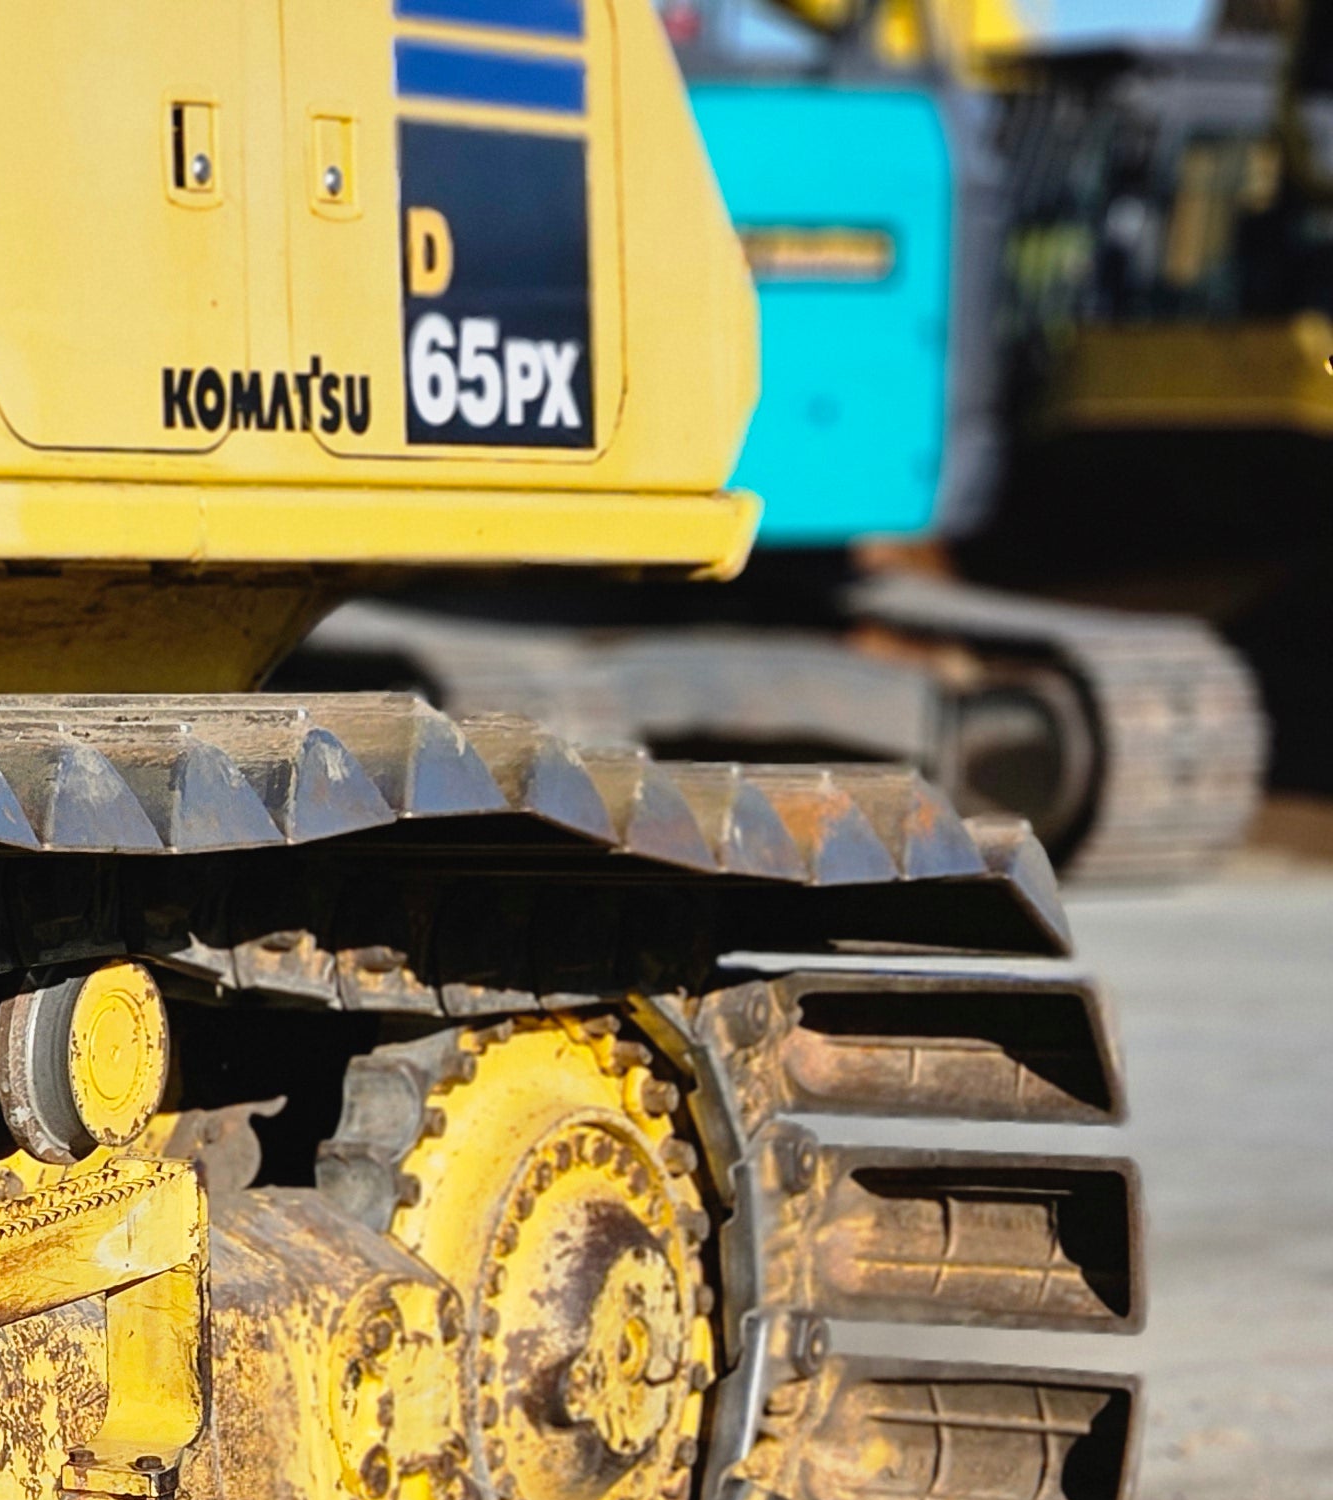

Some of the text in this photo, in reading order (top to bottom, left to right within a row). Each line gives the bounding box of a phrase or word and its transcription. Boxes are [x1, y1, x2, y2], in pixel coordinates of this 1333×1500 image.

[407, 207, 453, 297] D
[162, 355, 370, 435] KOMATSU
[409, 311, 582, 428] 65PX
